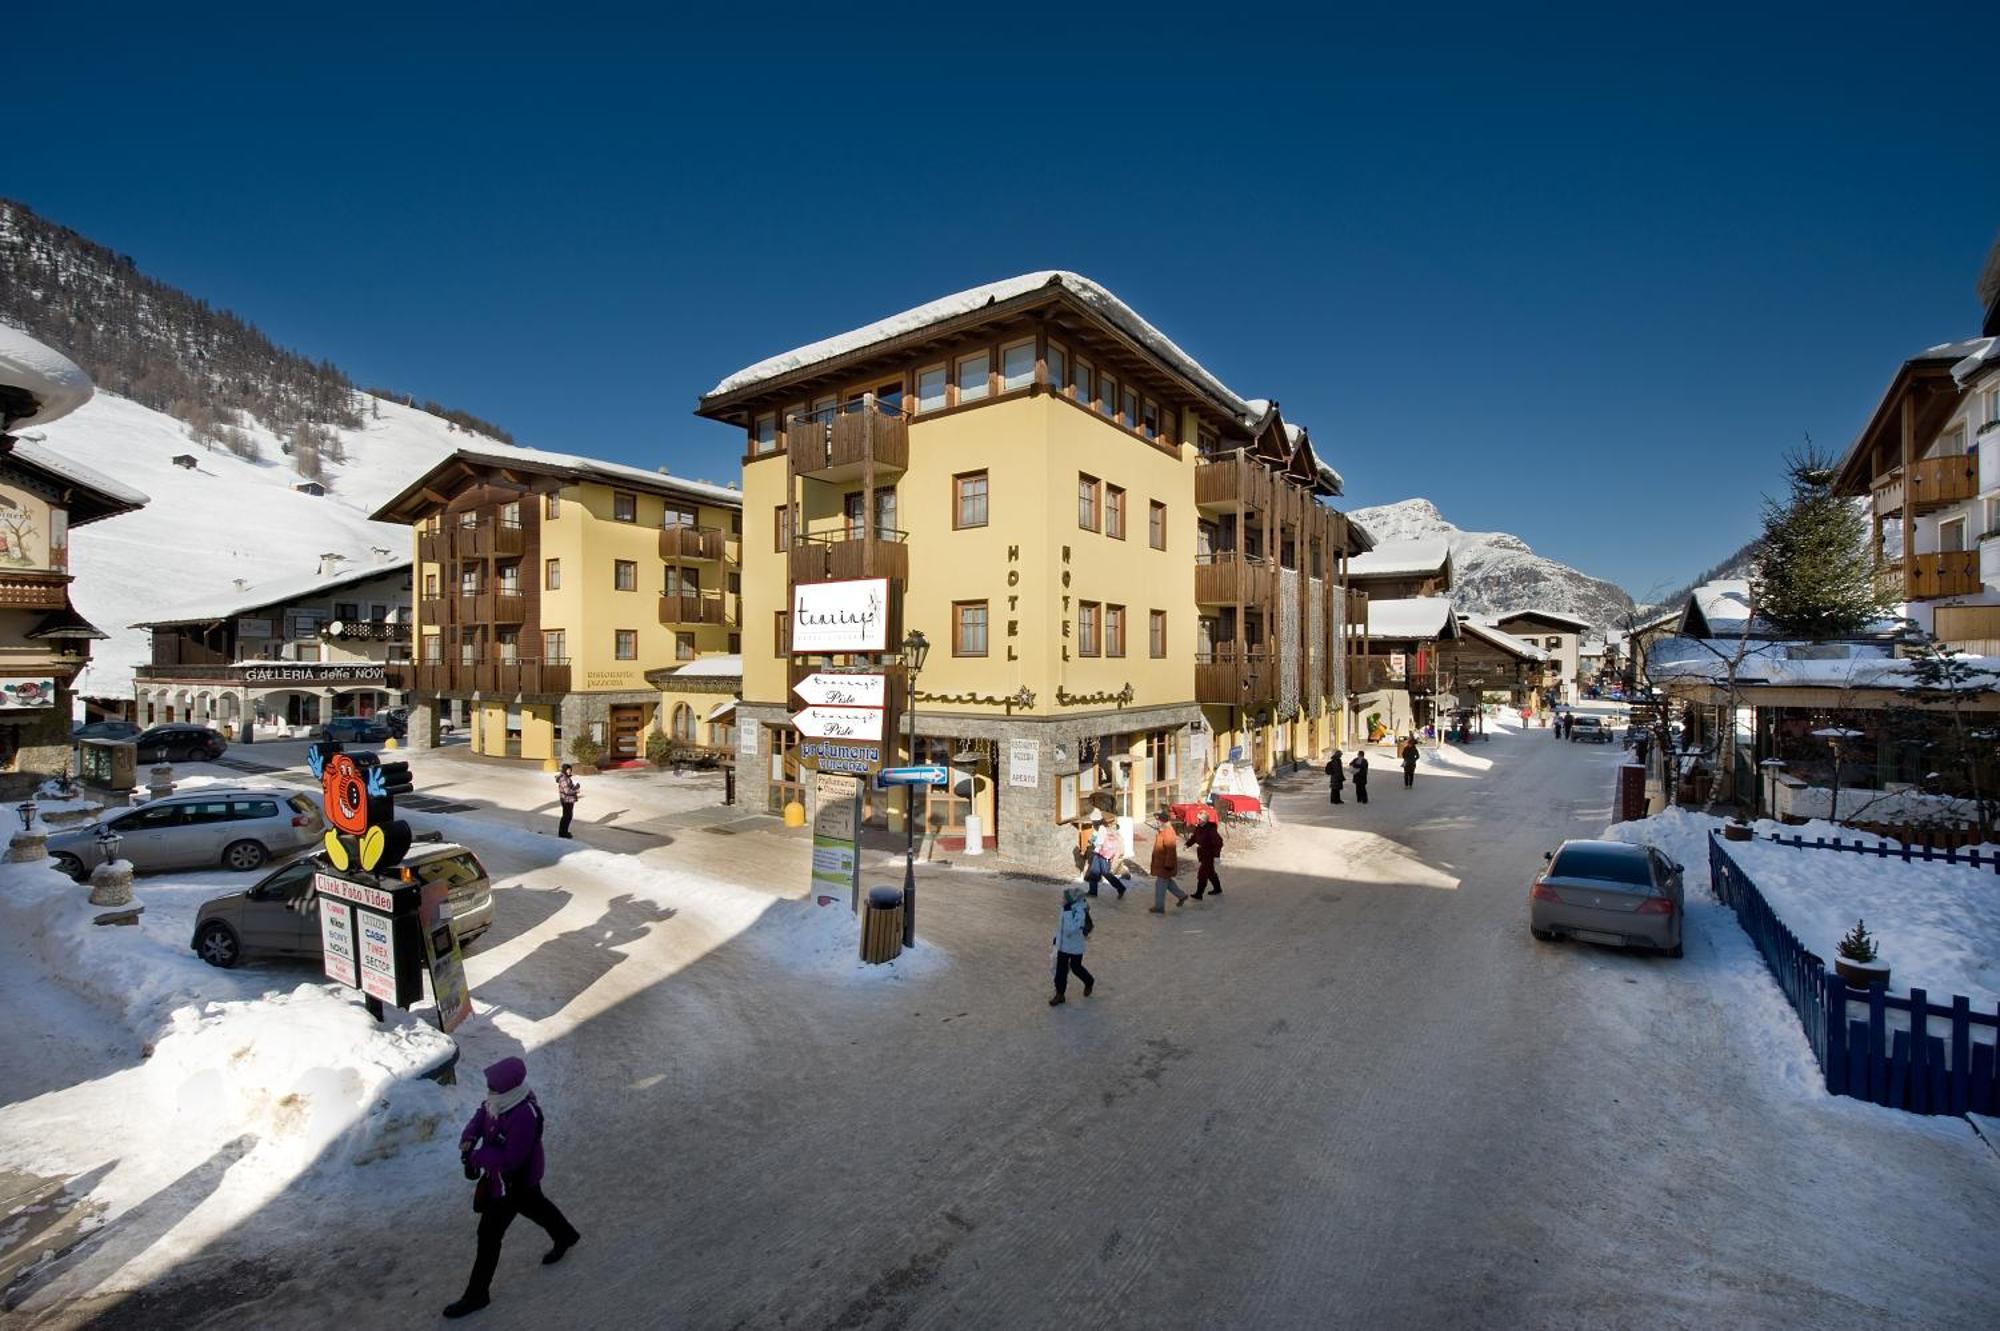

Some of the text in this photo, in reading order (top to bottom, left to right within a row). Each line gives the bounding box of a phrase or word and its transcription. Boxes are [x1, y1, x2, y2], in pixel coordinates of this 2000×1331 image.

[1007, 545, 1019, 662] HOTEL
[1061, 545, 1071, 662] HOTEL
[246, 668, 314, 681] GALLERIA
[319, 667, 350, 679] delle
[825, 690, 856, 704] Piste
[823, 722, 854, 735] Piste
[801, 741, 879, 762] profumeria
[317, 876, 392, 910] Click Foto Video
[365, 928, 387, 944] CASIO
[367, 941, 389, 959] TIMEX
